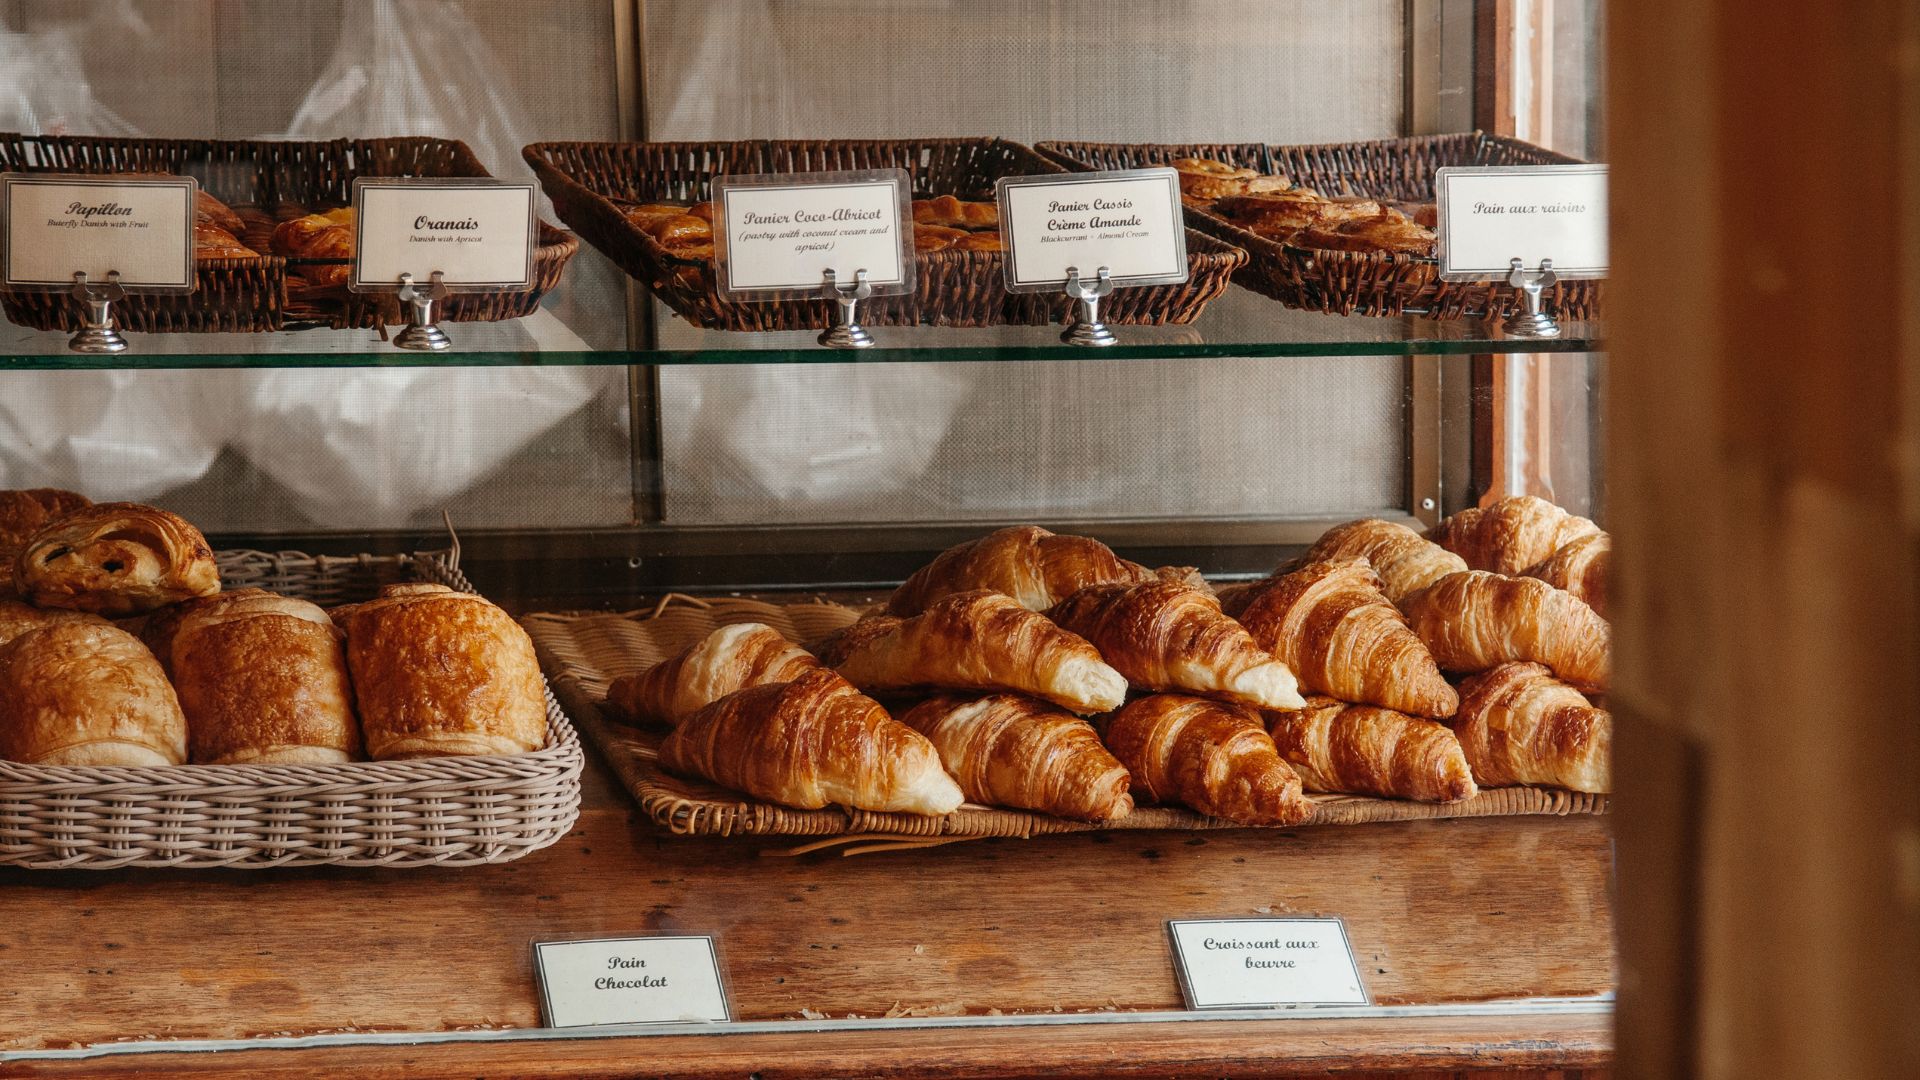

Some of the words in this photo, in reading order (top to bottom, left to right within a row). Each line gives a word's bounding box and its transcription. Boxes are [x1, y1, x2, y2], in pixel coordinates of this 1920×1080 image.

[65, 201, 132, 218] Papillon
[1048, 200, 1090, 213] Panier
[1093, 198, 1133, 211] Cassis
[1473, 201, 1505, 214] Pain
[1509, 205, 1537, 214] aux
[1541, 202, 1586, 213] raisins
[414, 215, 479, 230] Oranais
[743, 211, 790, 225] Panier
[794, 208, 881, 223] Coco-Abricot
[1047, 218, 1087, 231] Crème
[1089, 214, 1142, 229] Amande
[80, 219, 109, 228] Danish
[110, 220, 127, 228] with
[128, 221, 149, 229] Fruit
[409, 235, 436, 243] Danish
[437, 235, 454, 243] with
[455, 235, 482, 244] Apricot
[738, 230, 777, 242] (pastry
[778, 229, 800, 239] with
[802, 227, 838, 238] coconut
[839, 228, 867, 236] cream
[869, 225, 889, 234] and
[1040, 235, 1088, 243] Blackcurrant
[1097, 231, 1125, 239] Almond
[1125, 230, 1149, 239] Cream
[794, 241, 835, 254] apricot)
[1203, 937, 1282, 951] Croissant
[1285, 940, 1320, 949] aux
[607, 956, 647, 970] Pain
[1245, 956, 1297, 969] beurre
[594, 975, 669, 990] Chocolat
